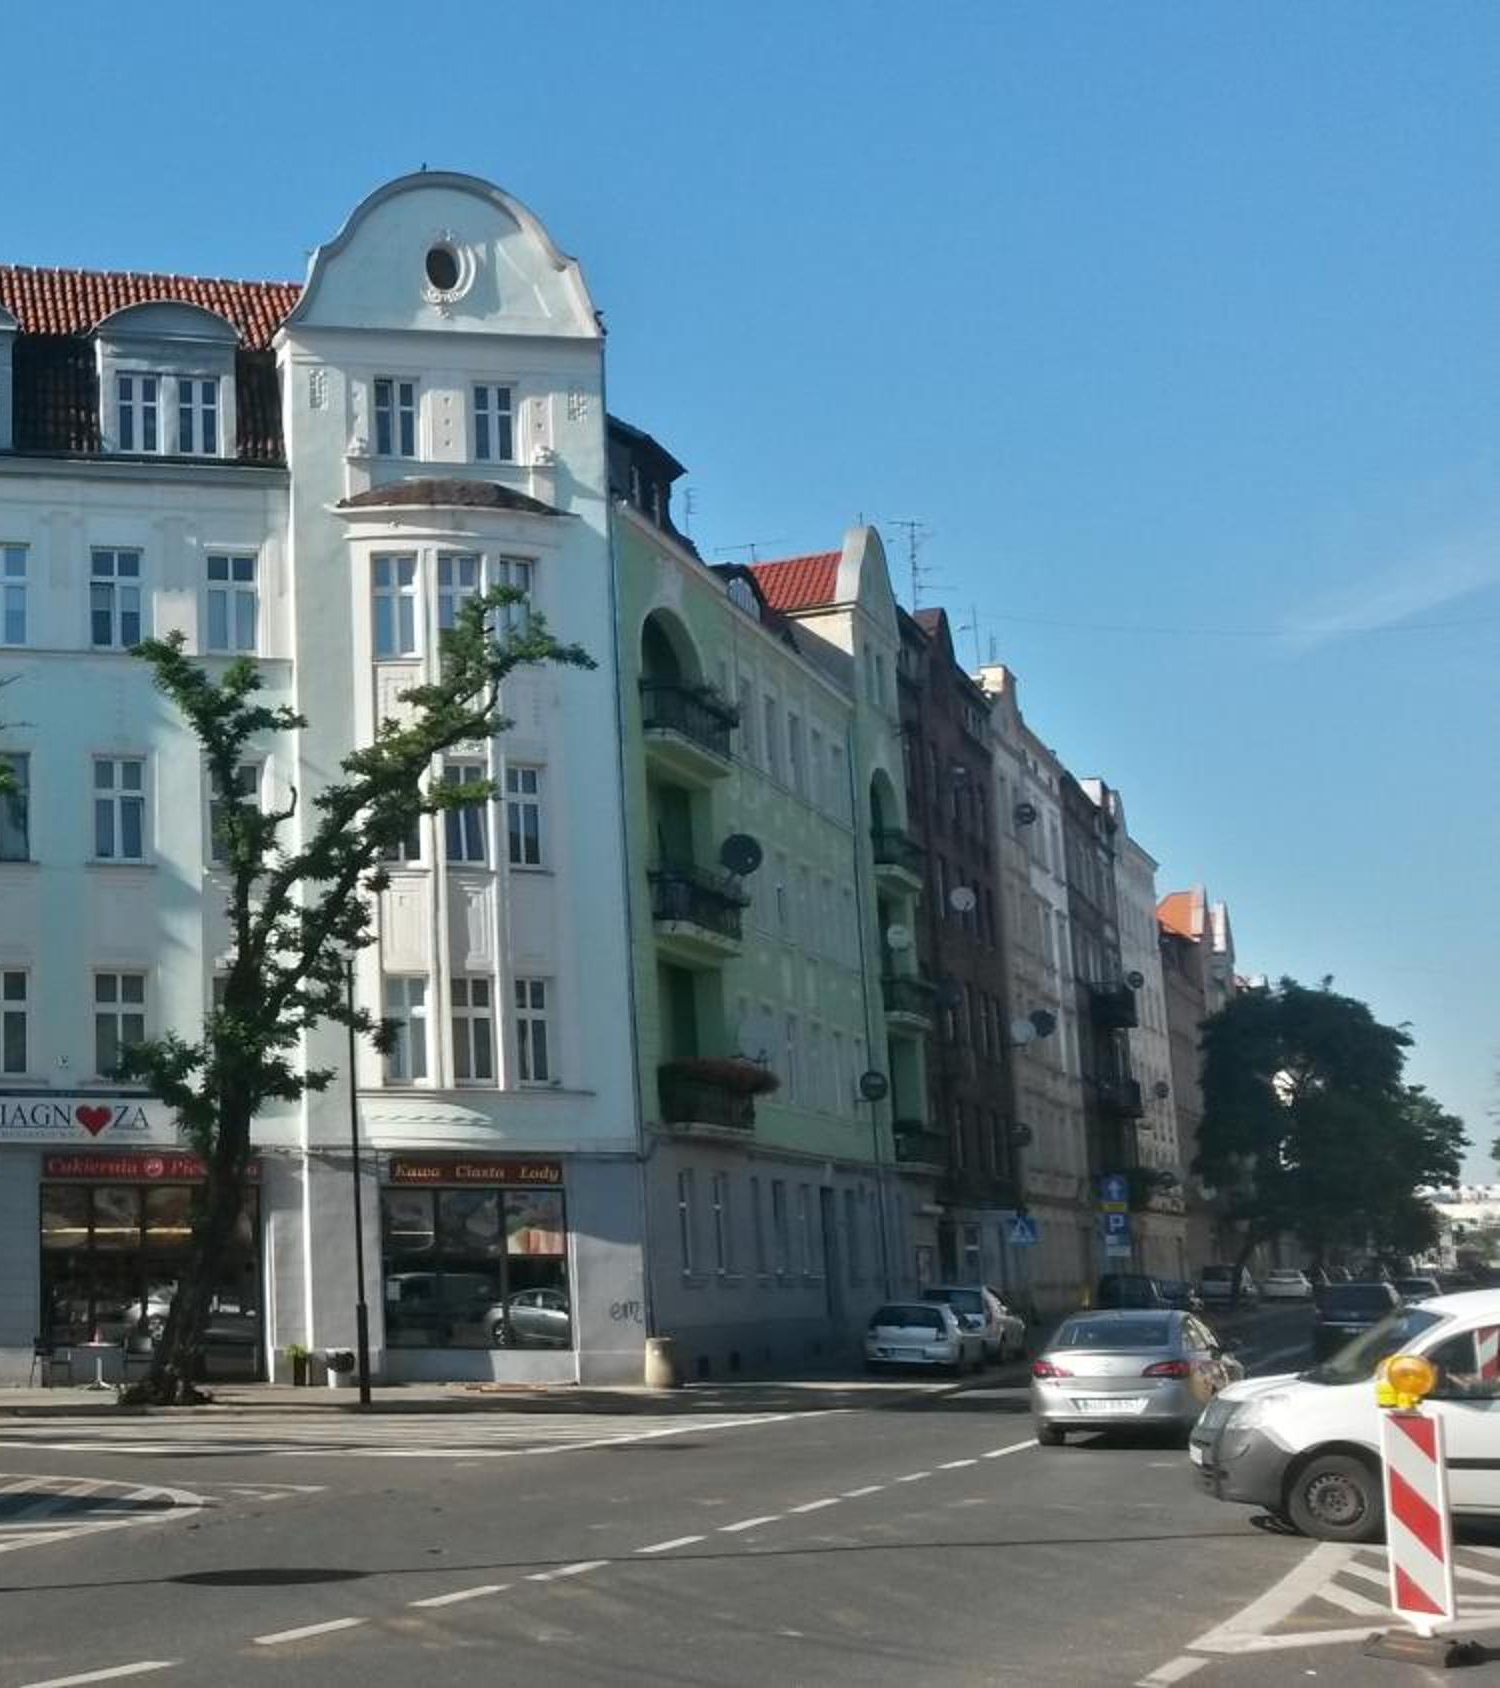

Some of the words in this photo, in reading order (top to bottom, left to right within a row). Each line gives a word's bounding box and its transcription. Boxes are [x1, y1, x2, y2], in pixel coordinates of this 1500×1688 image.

[48, 1157, 138, 1177] Cukiernia
[395, 1164, 441, 1178] Kawa
[455, 1164, 505, 1180] Ciasta
[518, 1166, 560, 1182] Lody
